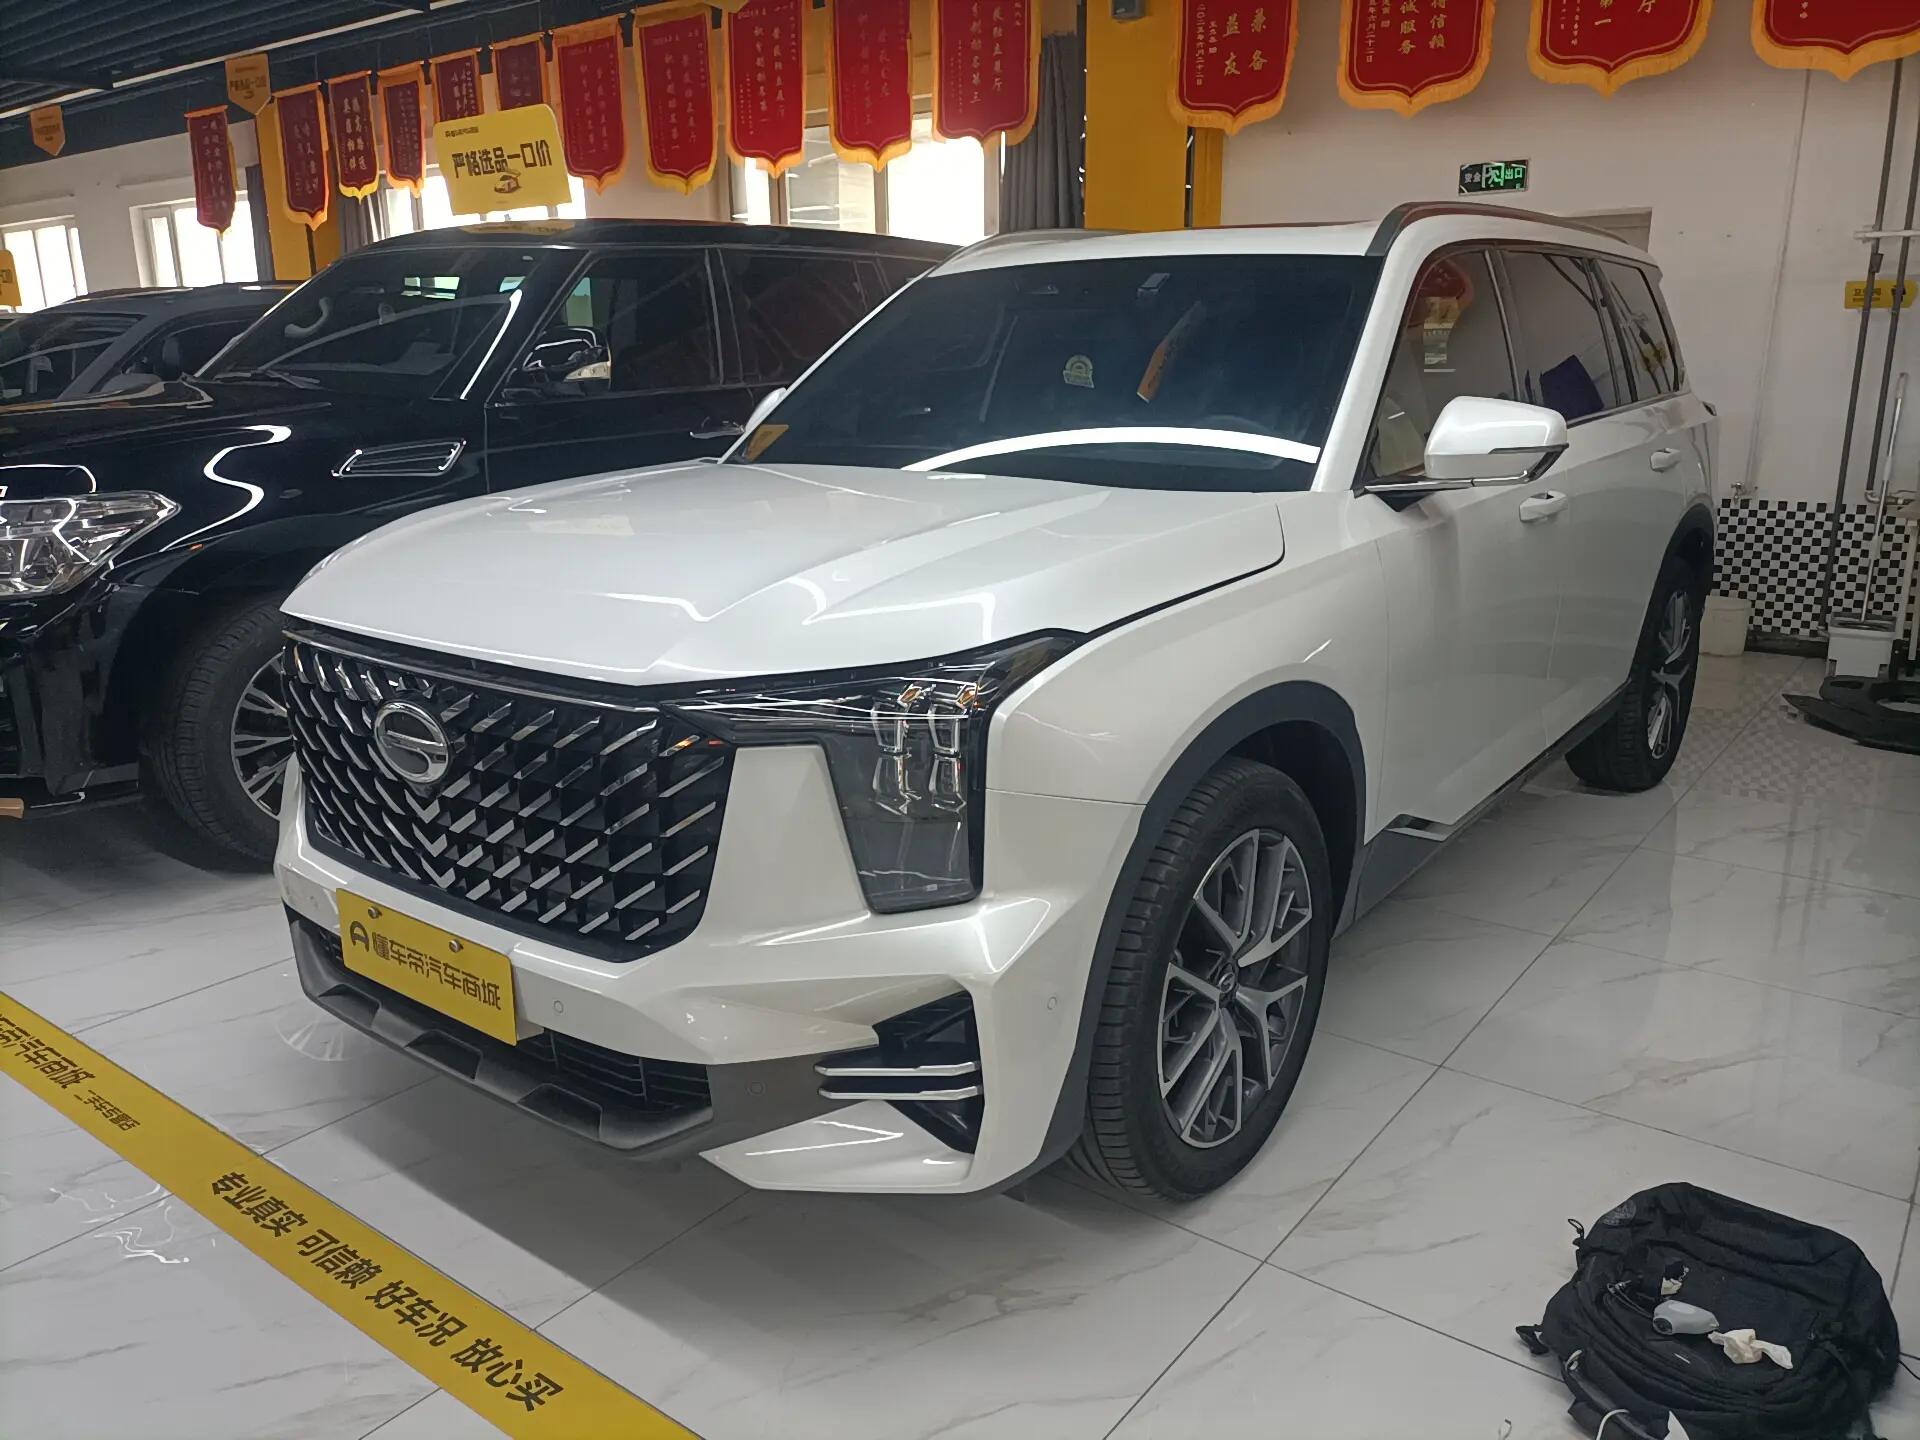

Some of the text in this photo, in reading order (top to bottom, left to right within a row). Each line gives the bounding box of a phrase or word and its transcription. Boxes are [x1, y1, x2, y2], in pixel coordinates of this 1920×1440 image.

[451, 139, 553, 179] 严格选品一口价
[371, 931, 502, 1011] 懂车帝汽车商城
[210, 1171, 565, 1412] 专业真实 可信赖 好车况 放心买
